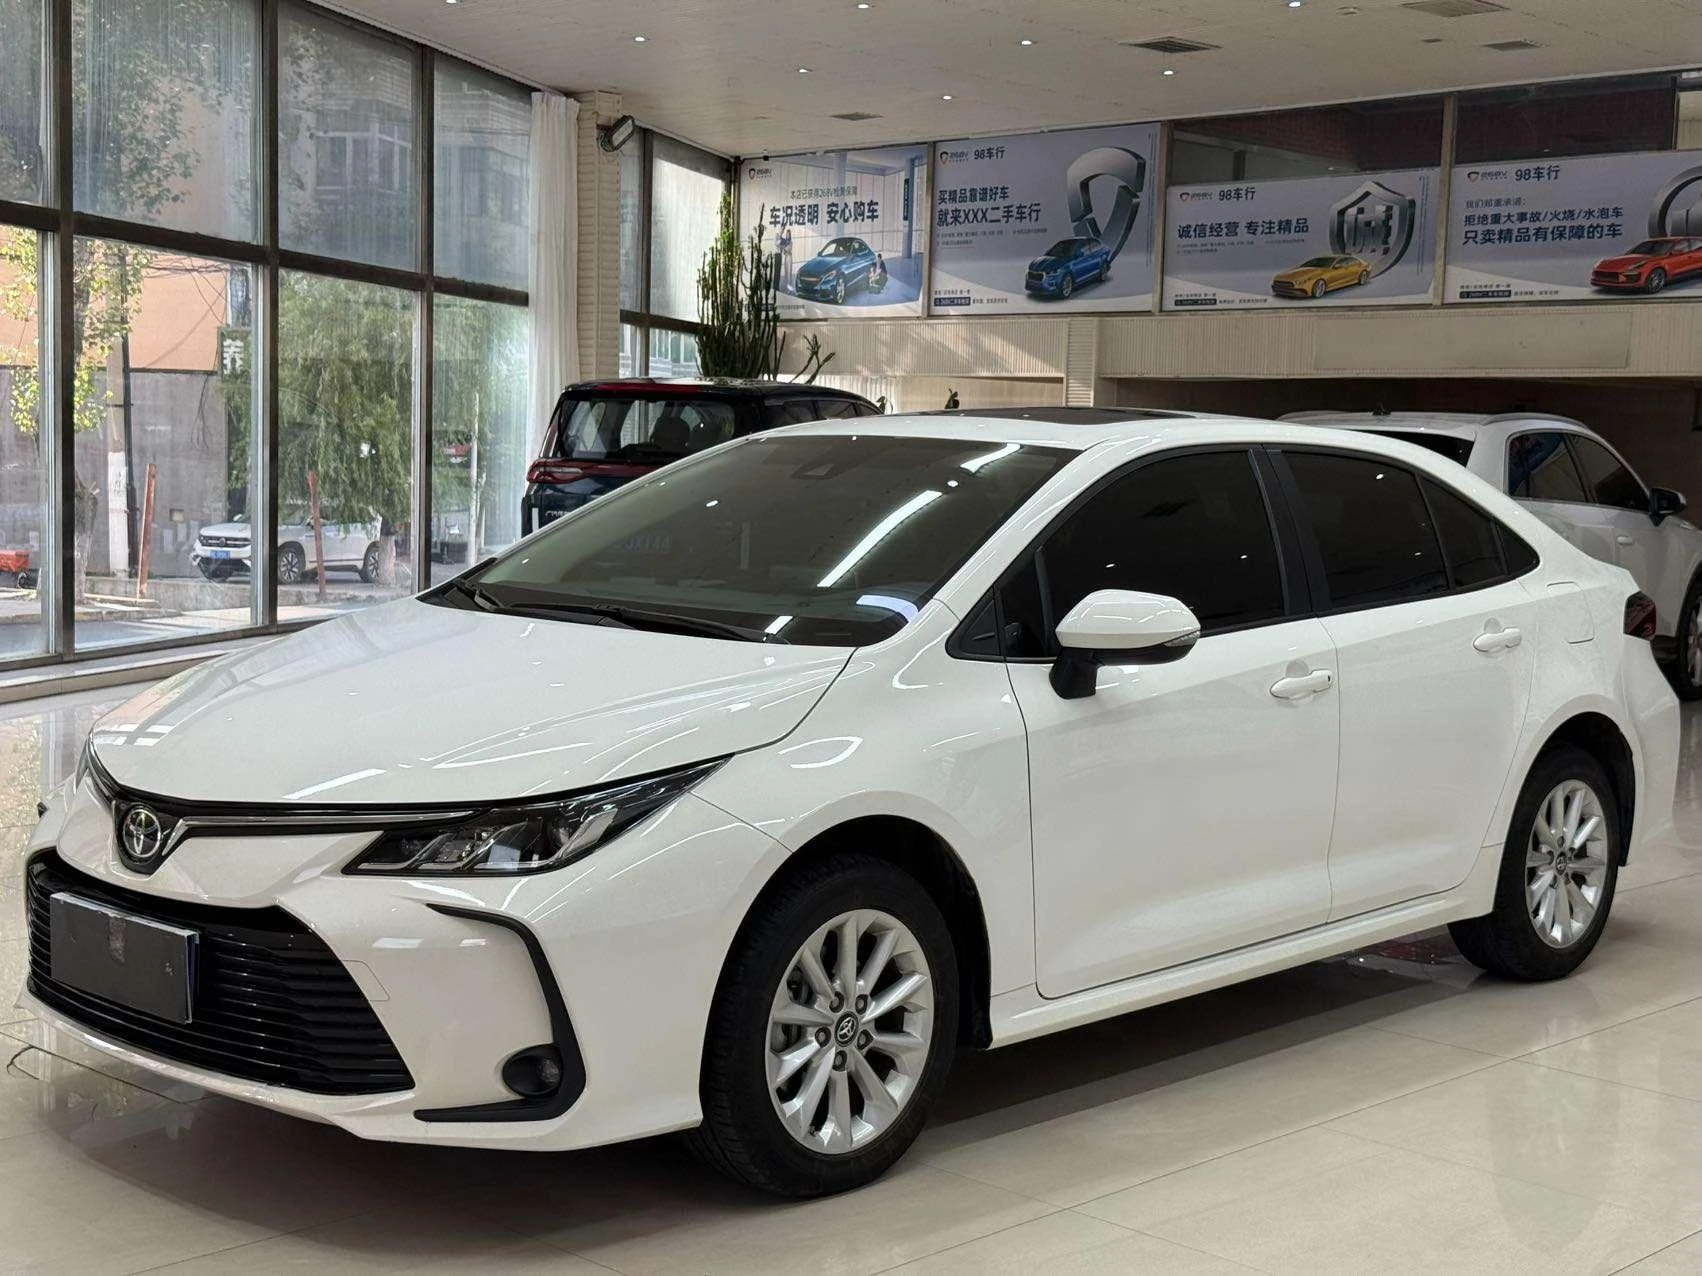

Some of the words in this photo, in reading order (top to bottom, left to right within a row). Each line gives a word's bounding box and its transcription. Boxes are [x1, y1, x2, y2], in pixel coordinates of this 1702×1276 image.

[974, 146, 1006, 160] 98车行
[1515, 165, 1561, 181] 98车行
[938, 185, 1010, 205] 买精品靠谱好车
[1218, 186, 1256, 201] 98车行
[769, 203, 819, 227] 车况透明
[826, 200, 879, 224] 安心购车
[936, 203, 1041, 228] 就来XXX二手车行
[1463, 206, 1623, 227] 拒绝重大事故/火烧/水泡车
[1177, 219, 1240, 240] 诚信经营
[1243, 217, 1310, 237] 专注精品
[1462, 223, 1623, 246] 只卖精品有保障的车
